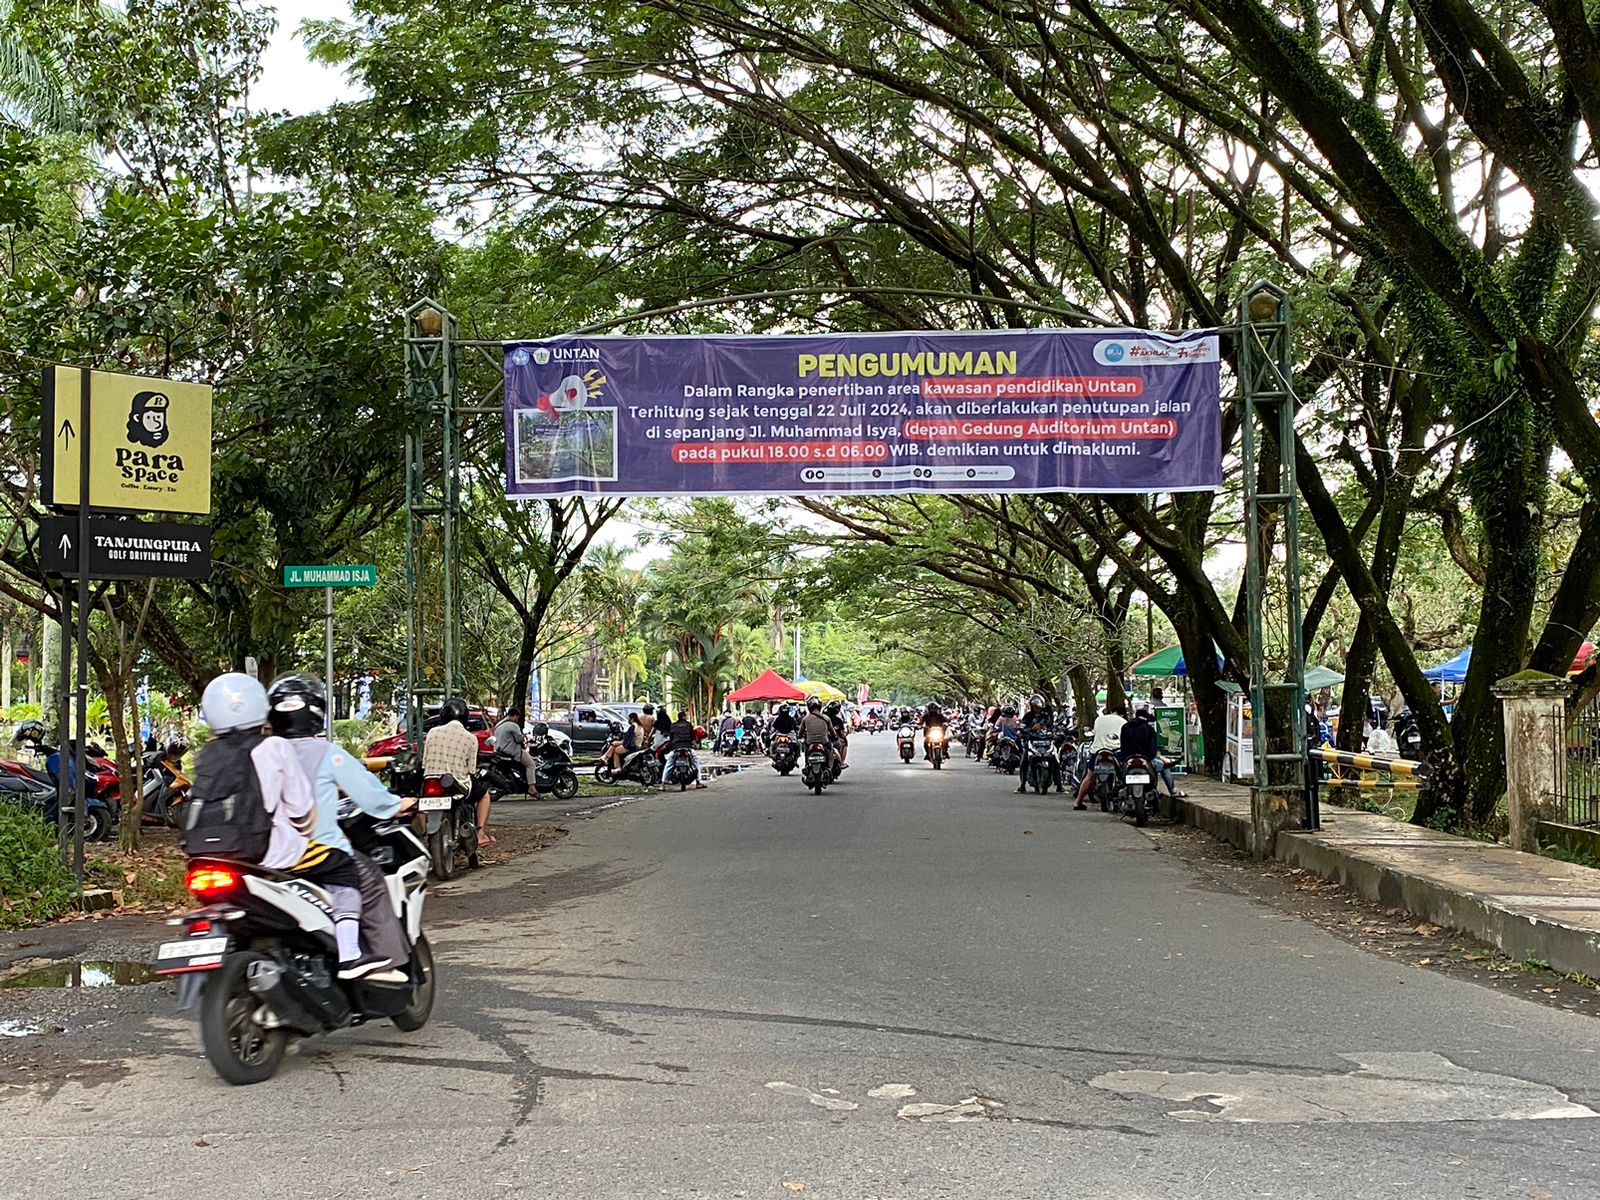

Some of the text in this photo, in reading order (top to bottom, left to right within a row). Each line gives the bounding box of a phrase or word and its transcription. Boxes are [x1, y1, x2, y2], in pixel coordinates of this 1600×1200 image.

[553, 348, 599, 359] UNTAN
[799, 351, 1017, 377] PENGUMUMAN
[684, 381, 1136, 402] Dalam Rangka penertiban area kawasan pendidikan Untan
[630, 400, 1190, 422] Terhitung sejak tenggal 22 Juli 2024, akan diberlakukan penutupan jalan
[646, 421, 1174, 441] di sepanjang Jl. Muhammad Isya, (depan Gedung Auditorium Untan)
[679, 442, 1140, 462] pada pukul 18.00 s.d 06.00 WIB. demikian untuk dimaklumi.
[94, 536, 201, 552] TANJUNGPURA
[109, 550, 188, 562] GOLF DRIVING RANGE
[290, 570, 370, 582] JL. MUHAMMAD ISJA
